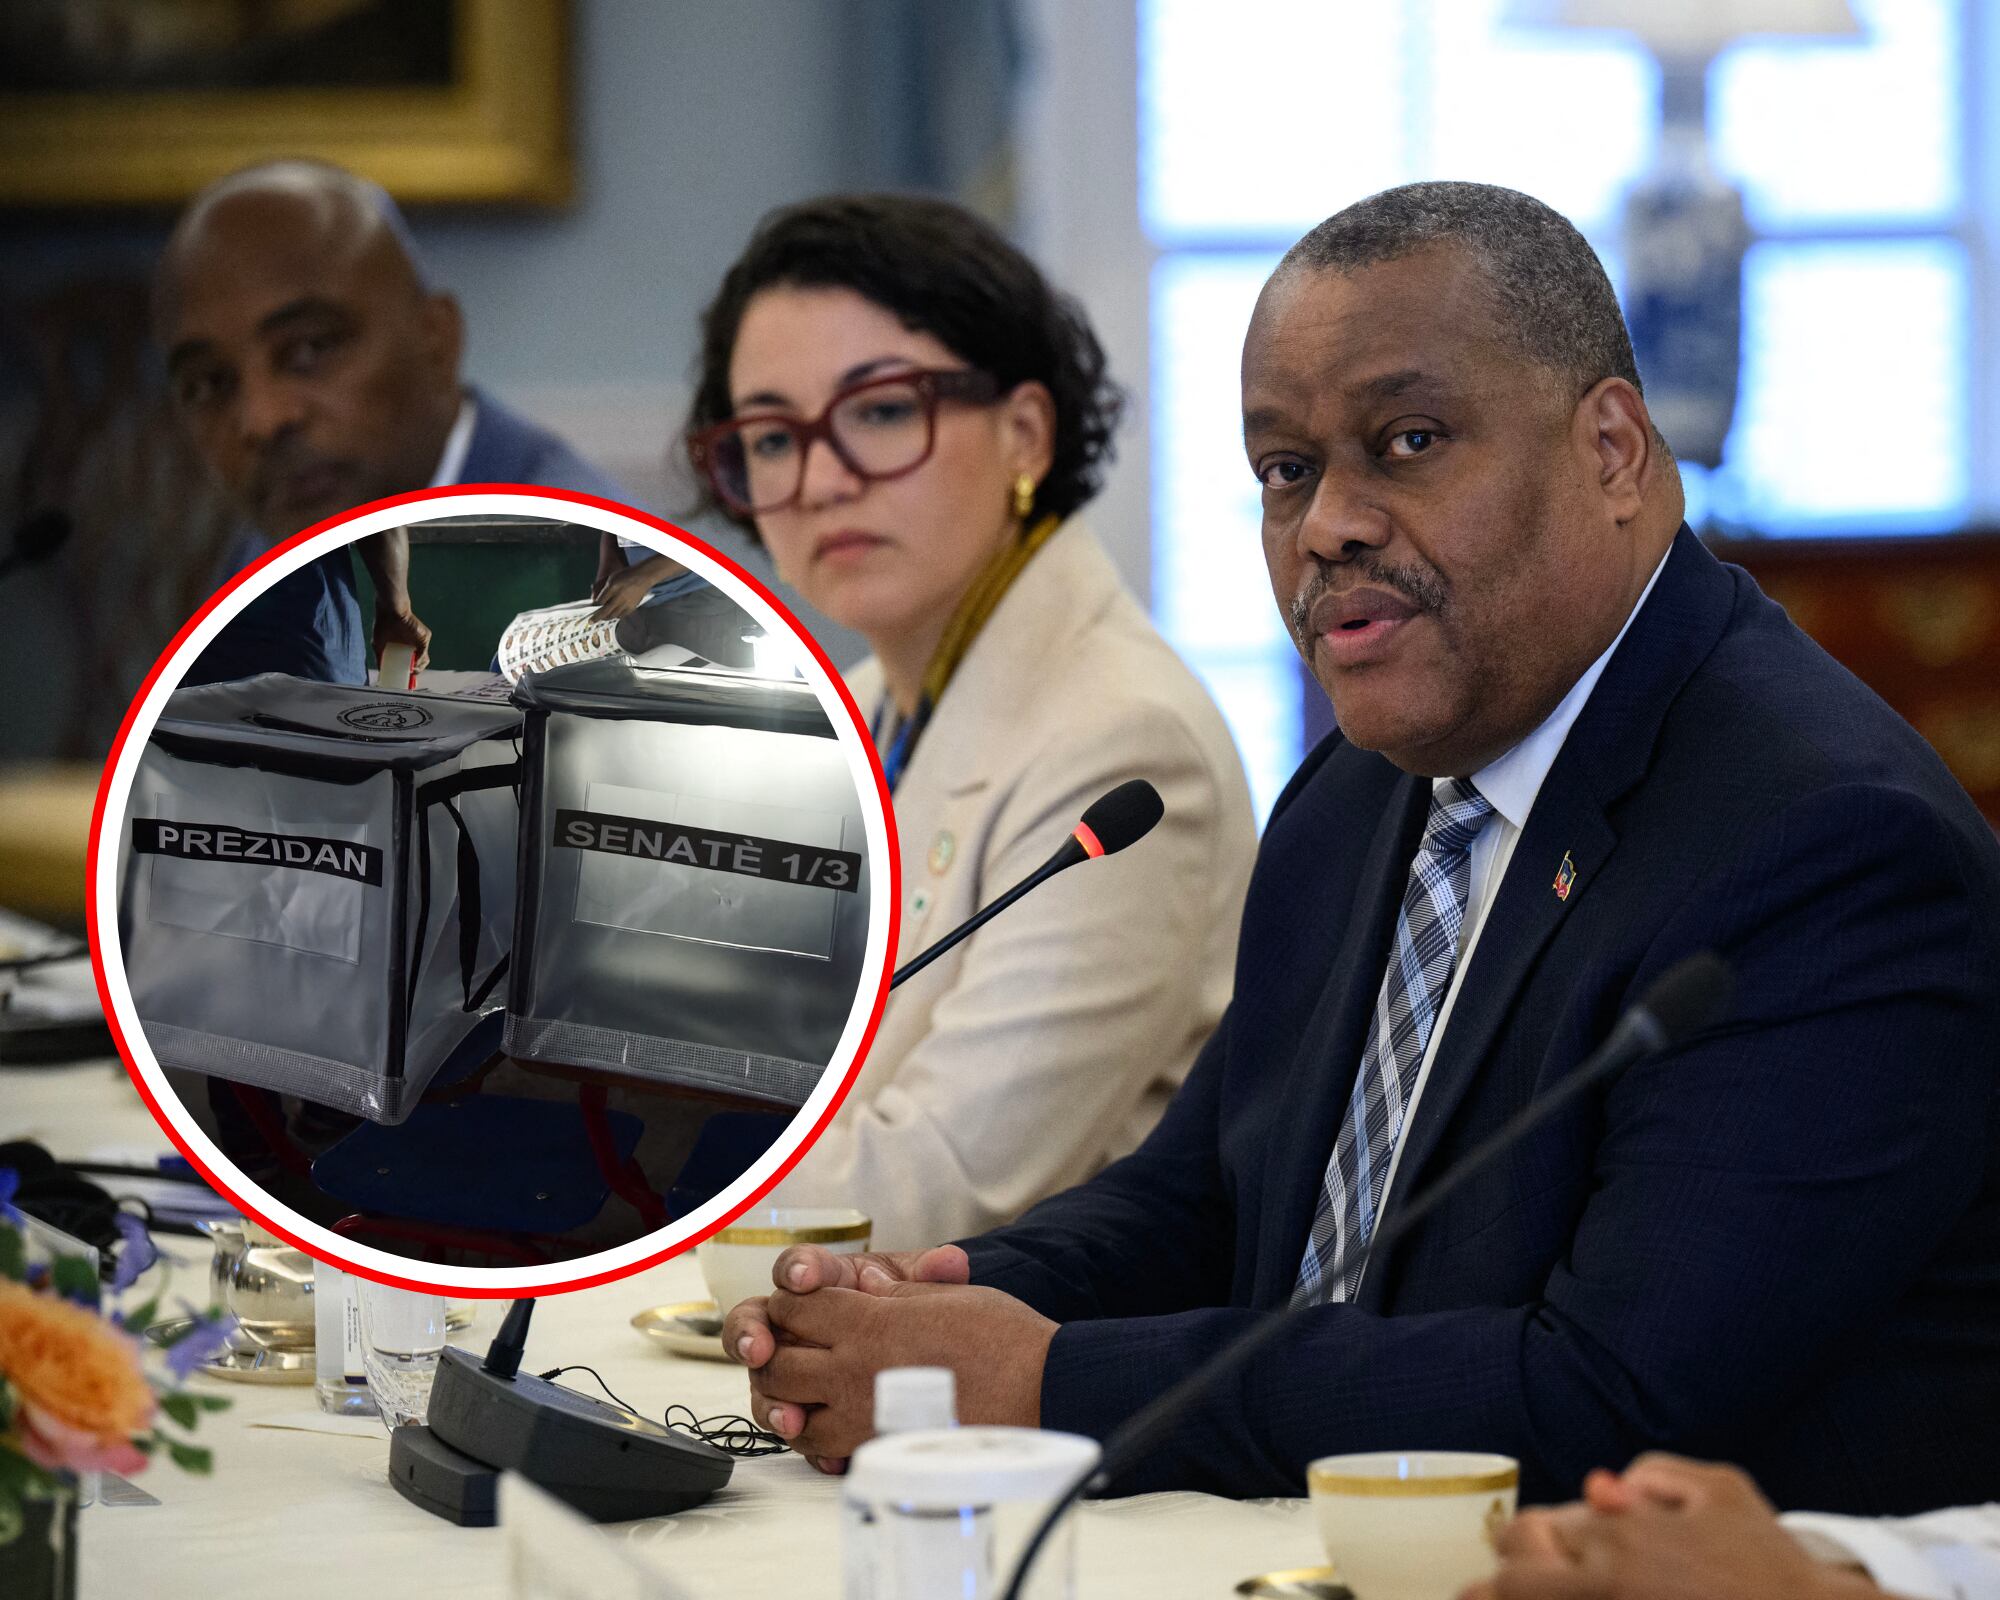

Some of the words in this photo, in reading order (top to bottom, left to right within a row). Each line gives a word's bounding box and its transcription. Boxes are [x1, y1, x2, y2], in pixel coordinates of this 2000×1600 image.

[158, 825, 367, 877] PREZIDAN
[565, 820, 763, 874] SENATÈ
[781, 853, 849, 886] 1/3
